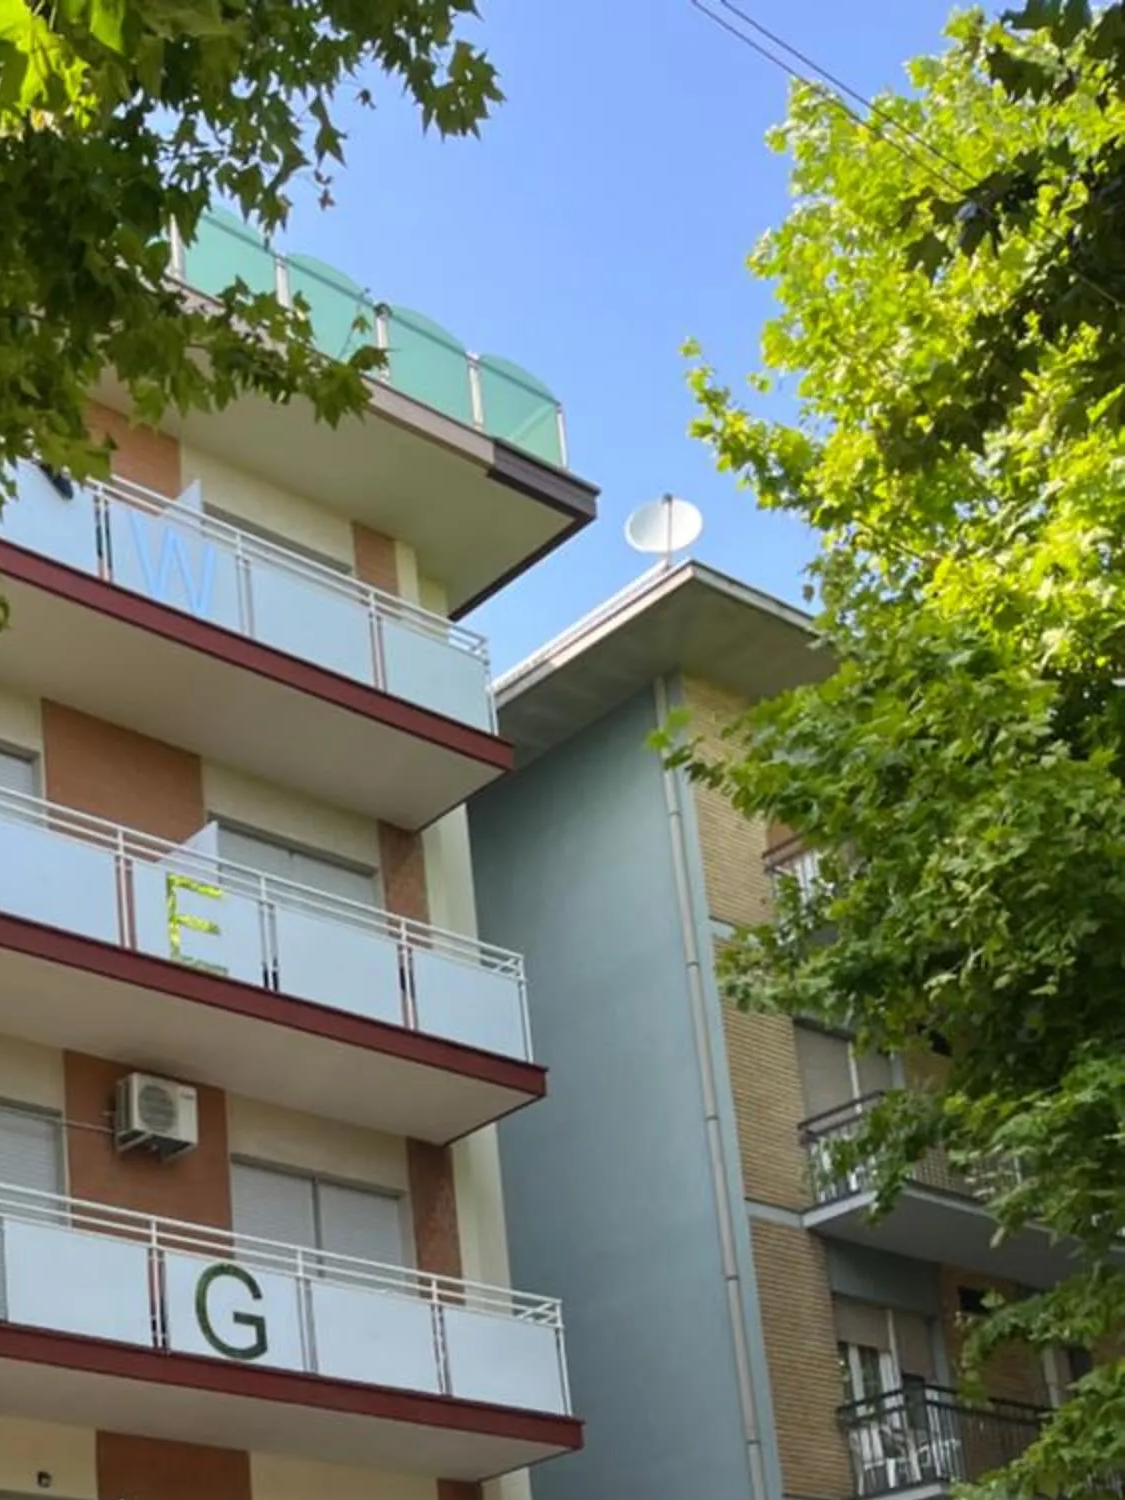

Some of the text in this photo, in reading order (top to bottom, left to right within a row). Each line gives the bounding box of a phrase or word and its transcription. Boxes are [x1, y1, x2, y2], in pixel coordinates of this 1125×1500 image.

[129, 509, 217, 614] W
[166, 873, 228, 973] E
[195, 1263, 268, 1360] G
